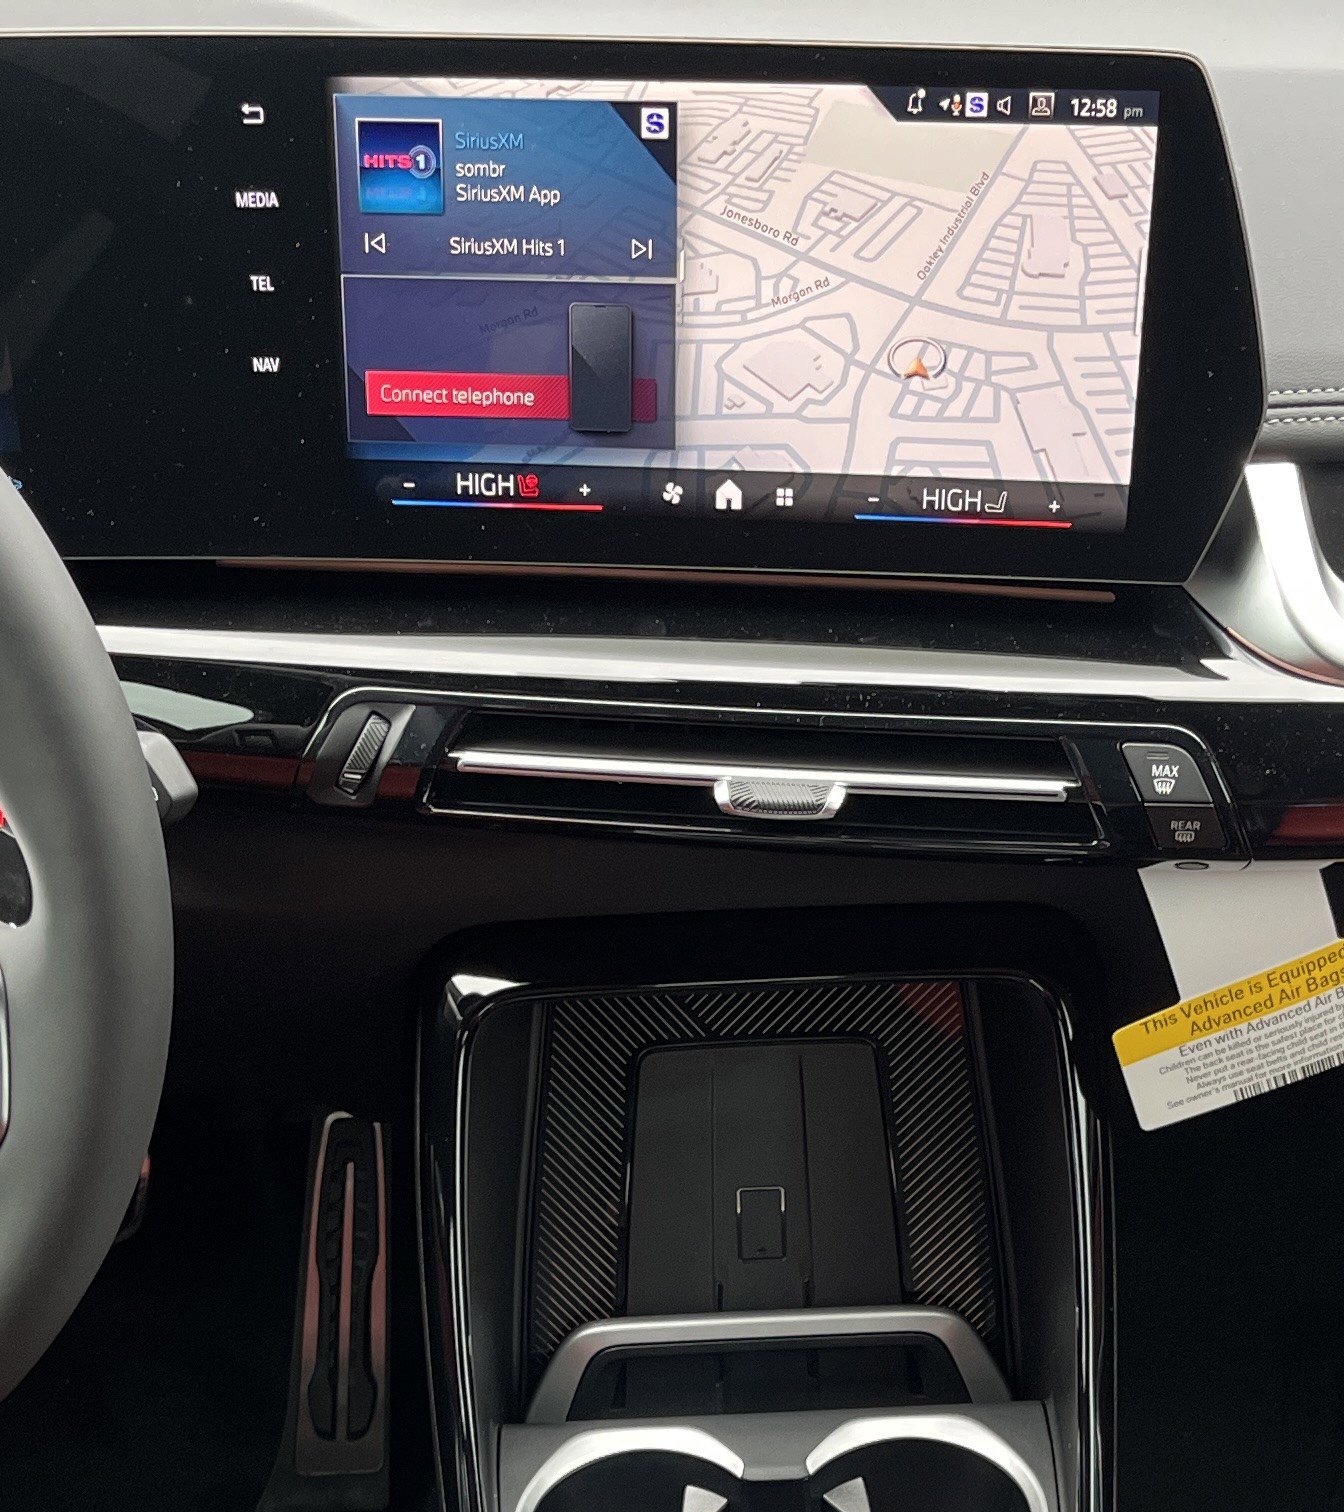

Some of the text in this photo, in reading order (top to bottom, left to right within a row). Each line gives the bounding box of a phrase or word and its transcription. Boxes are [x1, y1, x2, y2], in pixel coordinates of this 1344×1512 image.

[1071, 97, 1143, 120] 12:58 pm
[455, 131, 525, 150] SiriusXM
[363, 154, 413, 169] HITS
[455, 160, 506, 177] sombr
[235, 191, 279, 208] MEDIA
[456, 184, 561, 206] SiriusXM App
[719, 204, 800, 247] Jonesboro Rd
[917, 171, 990, 281] Oakley Industrial Blvd
[449, 237, 566, 256] SiriusXM Hits 1
[249, 275, 274, 292] TEL
[771, 277, 831, 308] Morgan Rd
[252, 357, 279, 373] NAV
[380, 384, 535, 408] Connect telephone
[456, 472, 515, 496] HIGH
[922, 487, 982, 512] HIGH
[1151, 764, 1179, 778] MAX
[1170, 820, 1201, 832] REAR
[1139, 1014, 1178, 1034] This
[1180, 988, 1244, 1018] Vehicle
[1247, 980, 1263, 995] is
[1191, 993, 1274, 1035] Advanced
[1280, 985, 1301, 1004] Air
[1179, 1039, 1212, 1057] Even
[1214, 1027, 1243, 1044] with
[1247, 1000, 1312, 1034] Advanced
[1315, 993, 1332, 1008] Air
